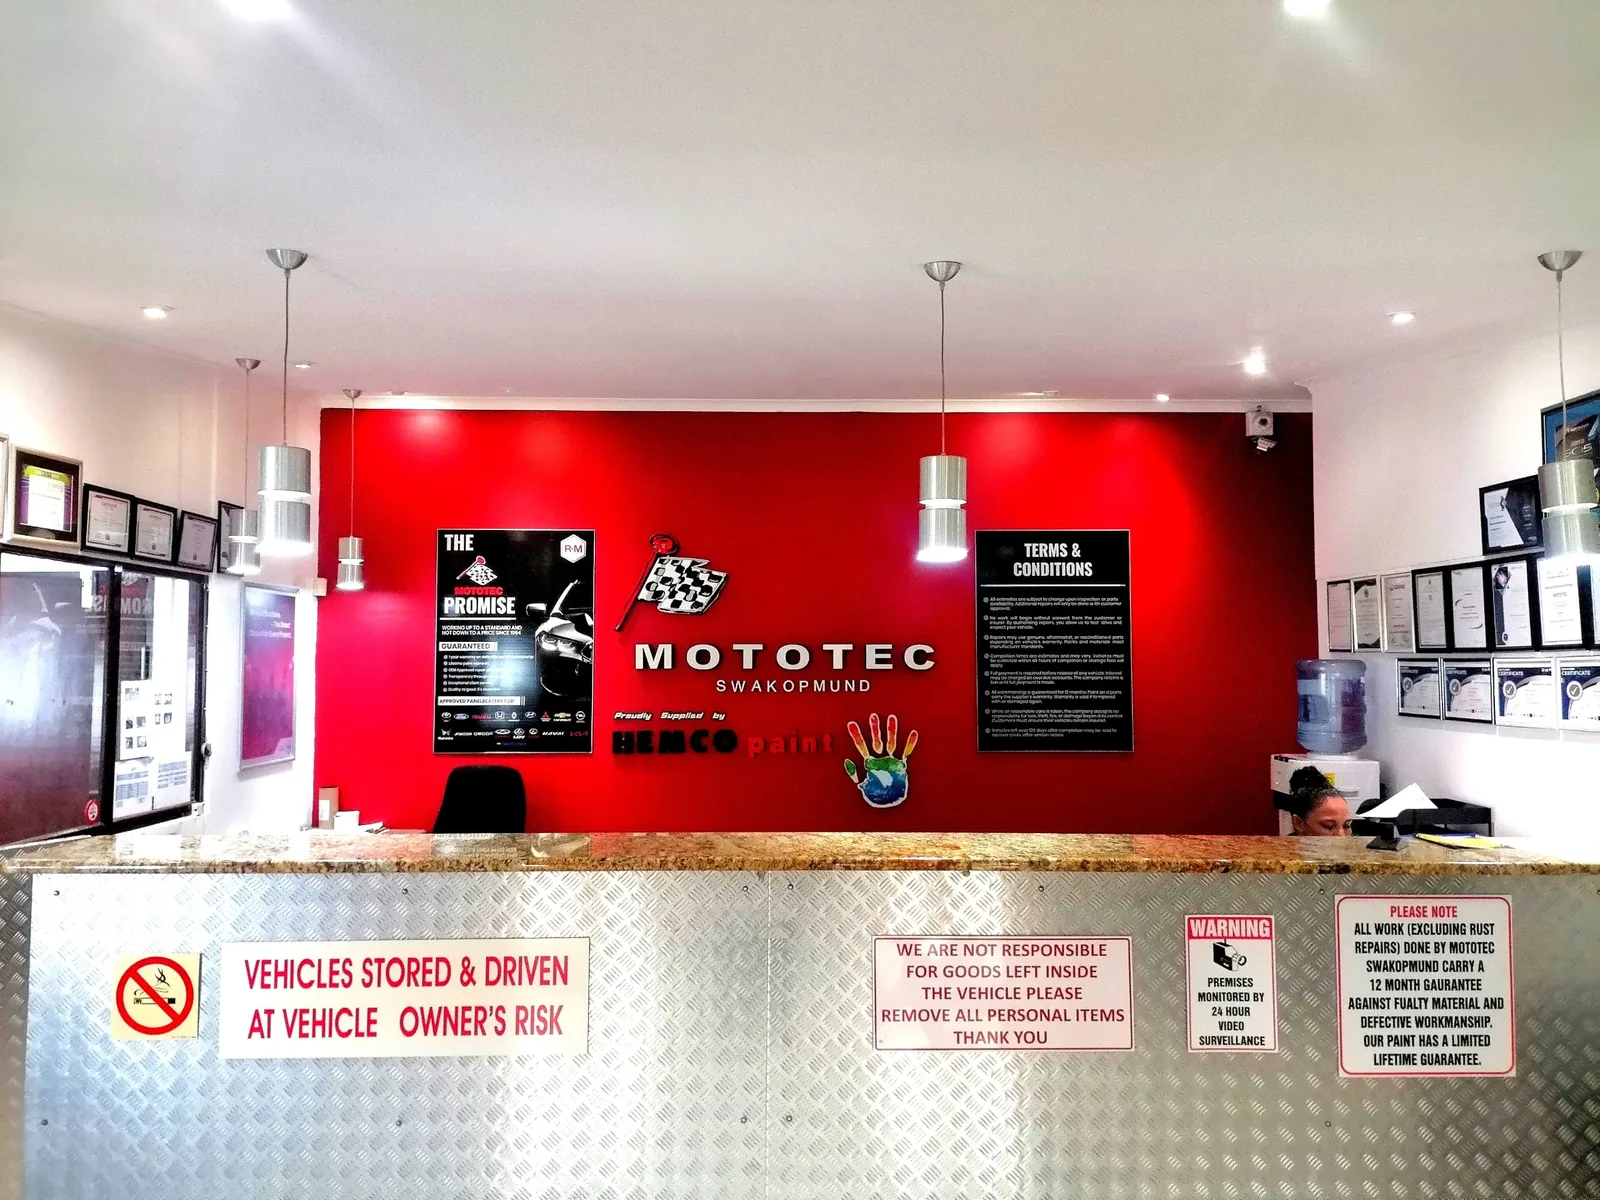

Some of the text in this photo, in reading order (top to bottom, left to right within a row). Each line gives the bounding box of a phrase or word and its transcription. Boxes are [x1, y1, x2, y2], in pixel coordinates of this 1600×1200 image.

[444, 534, 474, 551] THE
[1024, 543, 1081, 558] TERMS &
[1013, 562, 1093, 577] CONDITIONS
[454, 586, 504, 595] MOTOTEC
[444, 597, 516, 614] PROMISE
[634, 643, 936, 670] MOTOTEC
[716, 680, 871, 692] SWAKOPMUND
[614, 712, 726, 721] Proudly Supplied by
[612, 729, 834, 758] HEMCO paint
[1390, 906, 1458, 918] PLEASE NOTE
[1190, 918, 1271, 938] WARNING
[1354, 923, 1495, 937] ALL WORK (EXCLUDING RUST
[896, 943, 1108, 957] WE ARE NOT RESPONSIBLE
[1355, 942, 1495, 955] REPAIRS) DONE BY MOTOTEC
[244, 955, 568, 990] VEHICLES STORED & DRIVEN
[906, 965, 1098, 978] FOR GOODS LEFT INSIDE
[1366, 960, 1484, 972] SWAKOPMUND CARRY A
[1208, 977, 1253, 988] PREMISES
[1370, 978, 1482, 991] 12 MONTH GAURANTEE
[922, 986, 1082, 1000] THE VEHICLE PLEASE
[1198, 992, 1264, 1002] MONITORED BY
[1348, 997, 1504, 1010] AGAINST FUALTY MATERIAL AND
[882, 1008, 1124, 1022] REMOVE ALL PERSONAL ITEMS
[1212, 1006, 1250, 1016] 24 HOUR
[248, 1004, 564, 1039] AT VEHICLE OWNER'S RISK
[1218, 1021, 1244, 1031] VIDEO
[1360, 1016, 1493, 1028] DEFECTIVE WORKMANSHIP.
[953, 1030, 1048, 1044] THANK YOU
[1199, 1036, 1266, 1046] SURVEILLANCE
[1363, 1034, 1491, 1047] OUR PAINT HAS A LIMITED
[1373, 1053, 1482, 1066] LIFETIME GUARANTEE.
